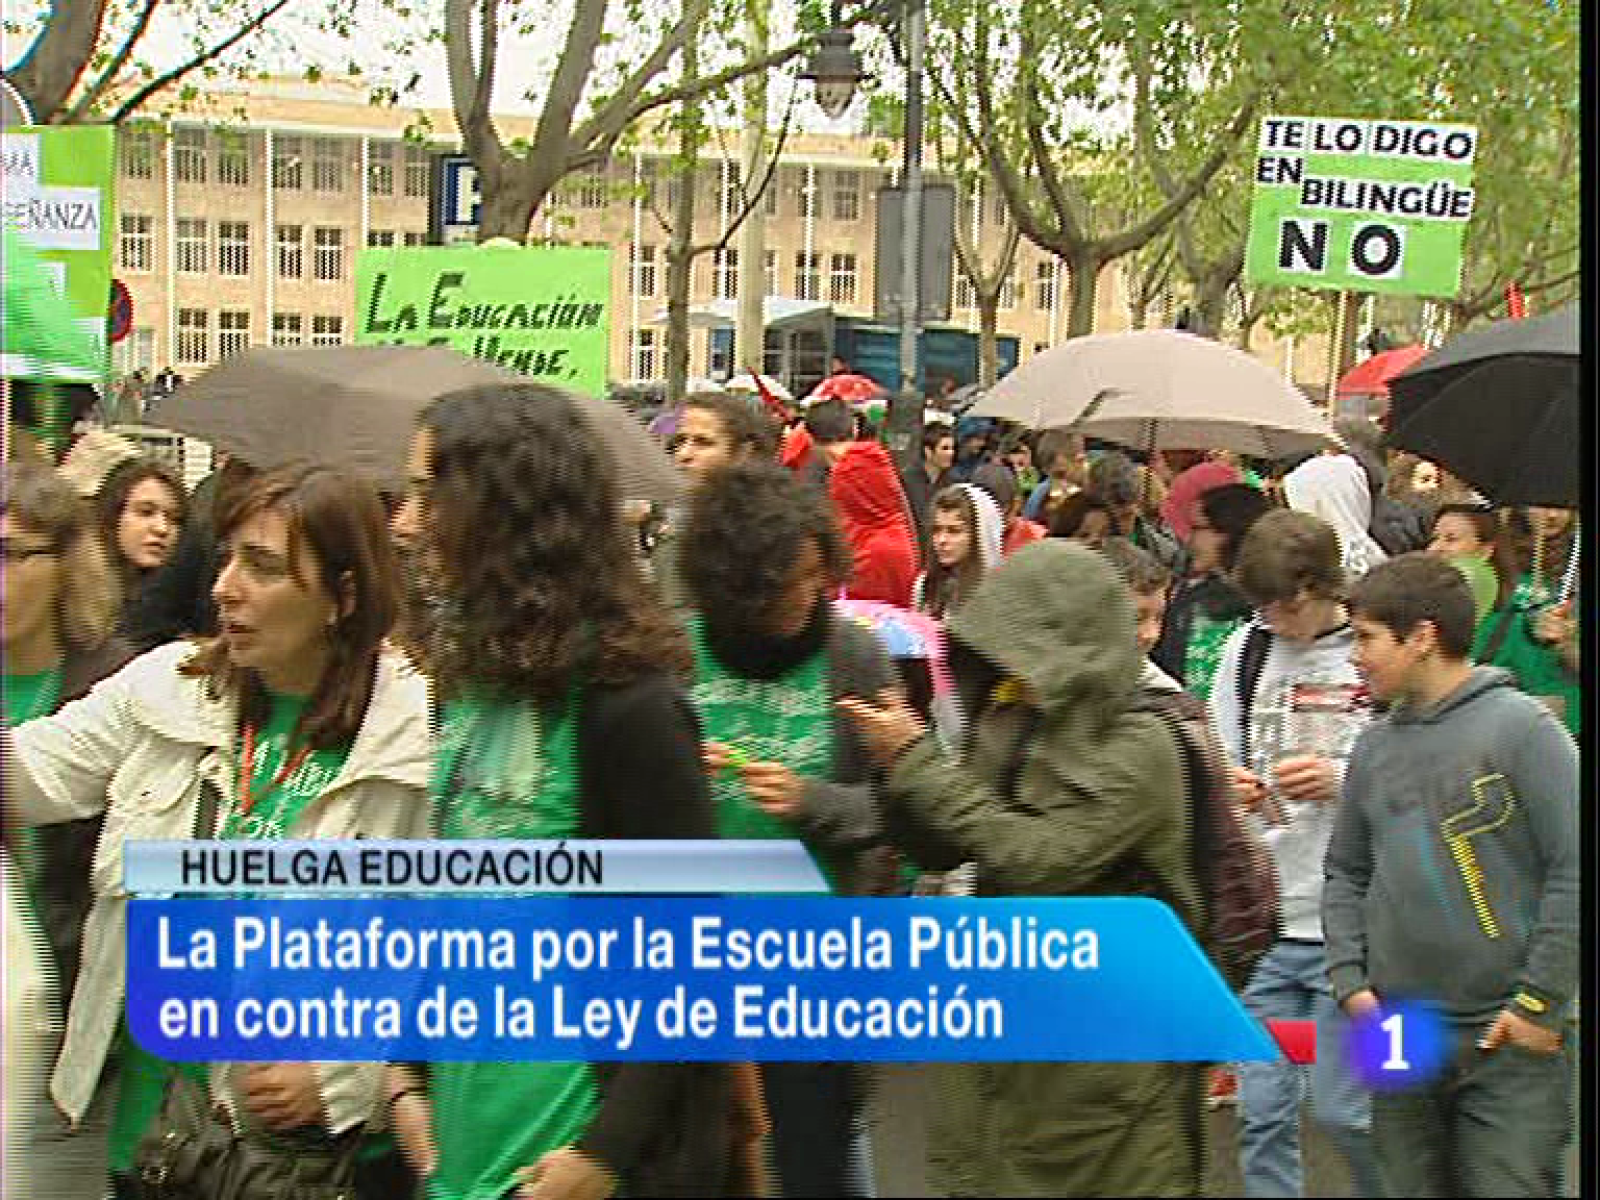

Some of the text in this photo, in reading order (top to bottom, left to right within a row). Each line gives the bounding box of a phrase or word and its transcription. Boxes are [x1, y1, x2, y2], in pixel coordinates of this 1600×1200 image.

[1266, 121, 1473, 159] TE LO DIGO
[1257, 157, 1471, 217] EN BILINGÜE
[1279, 220, 1401, 275] NO
